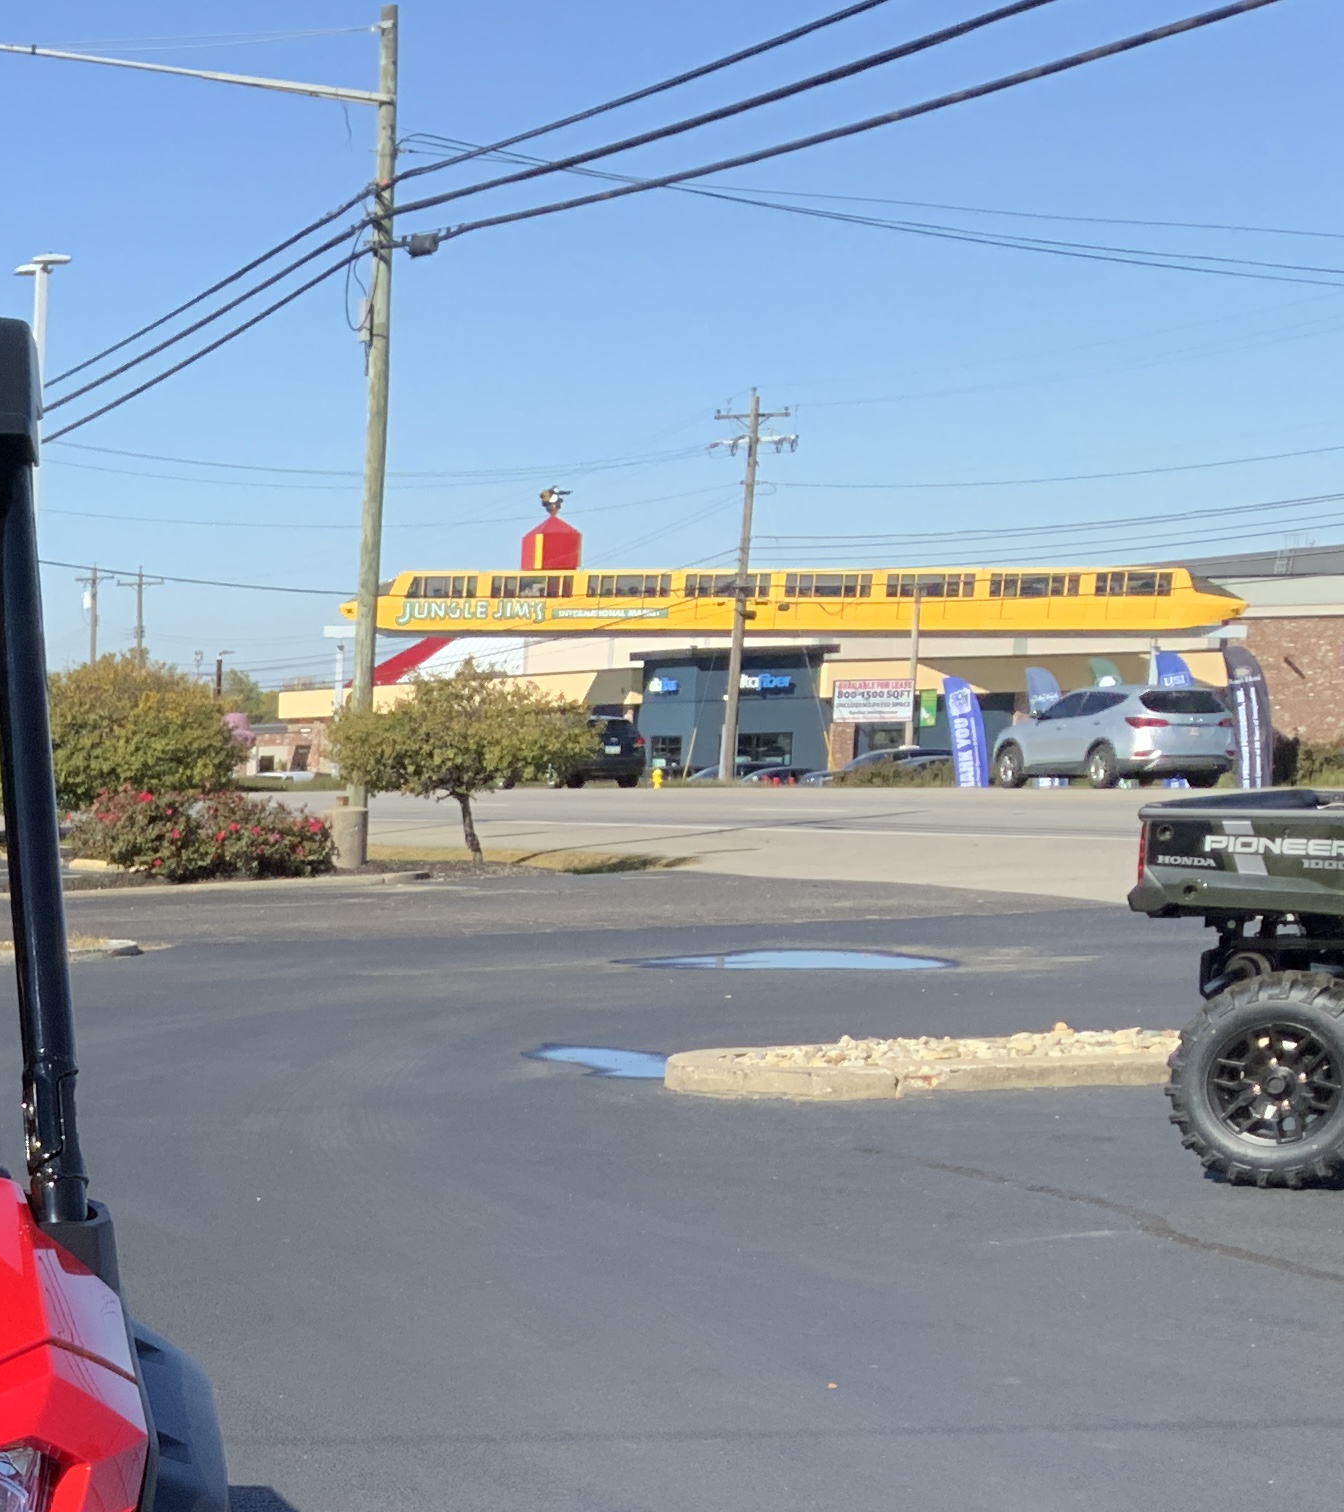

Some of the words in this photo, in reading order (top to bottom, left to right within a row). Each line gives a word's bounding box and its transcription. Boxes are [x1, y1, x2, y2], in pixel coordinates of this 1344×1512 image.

[395, 599, 489, 625] JUNGLE
[493, 599, 545, 624] JIM'S
[1163, 674, 1186, 686] USI
[886, 690, 912, 699] SQFT
[1204, 834, 1344, 857] PIONEER
[1156, 855, 1217, 867] HONDA
